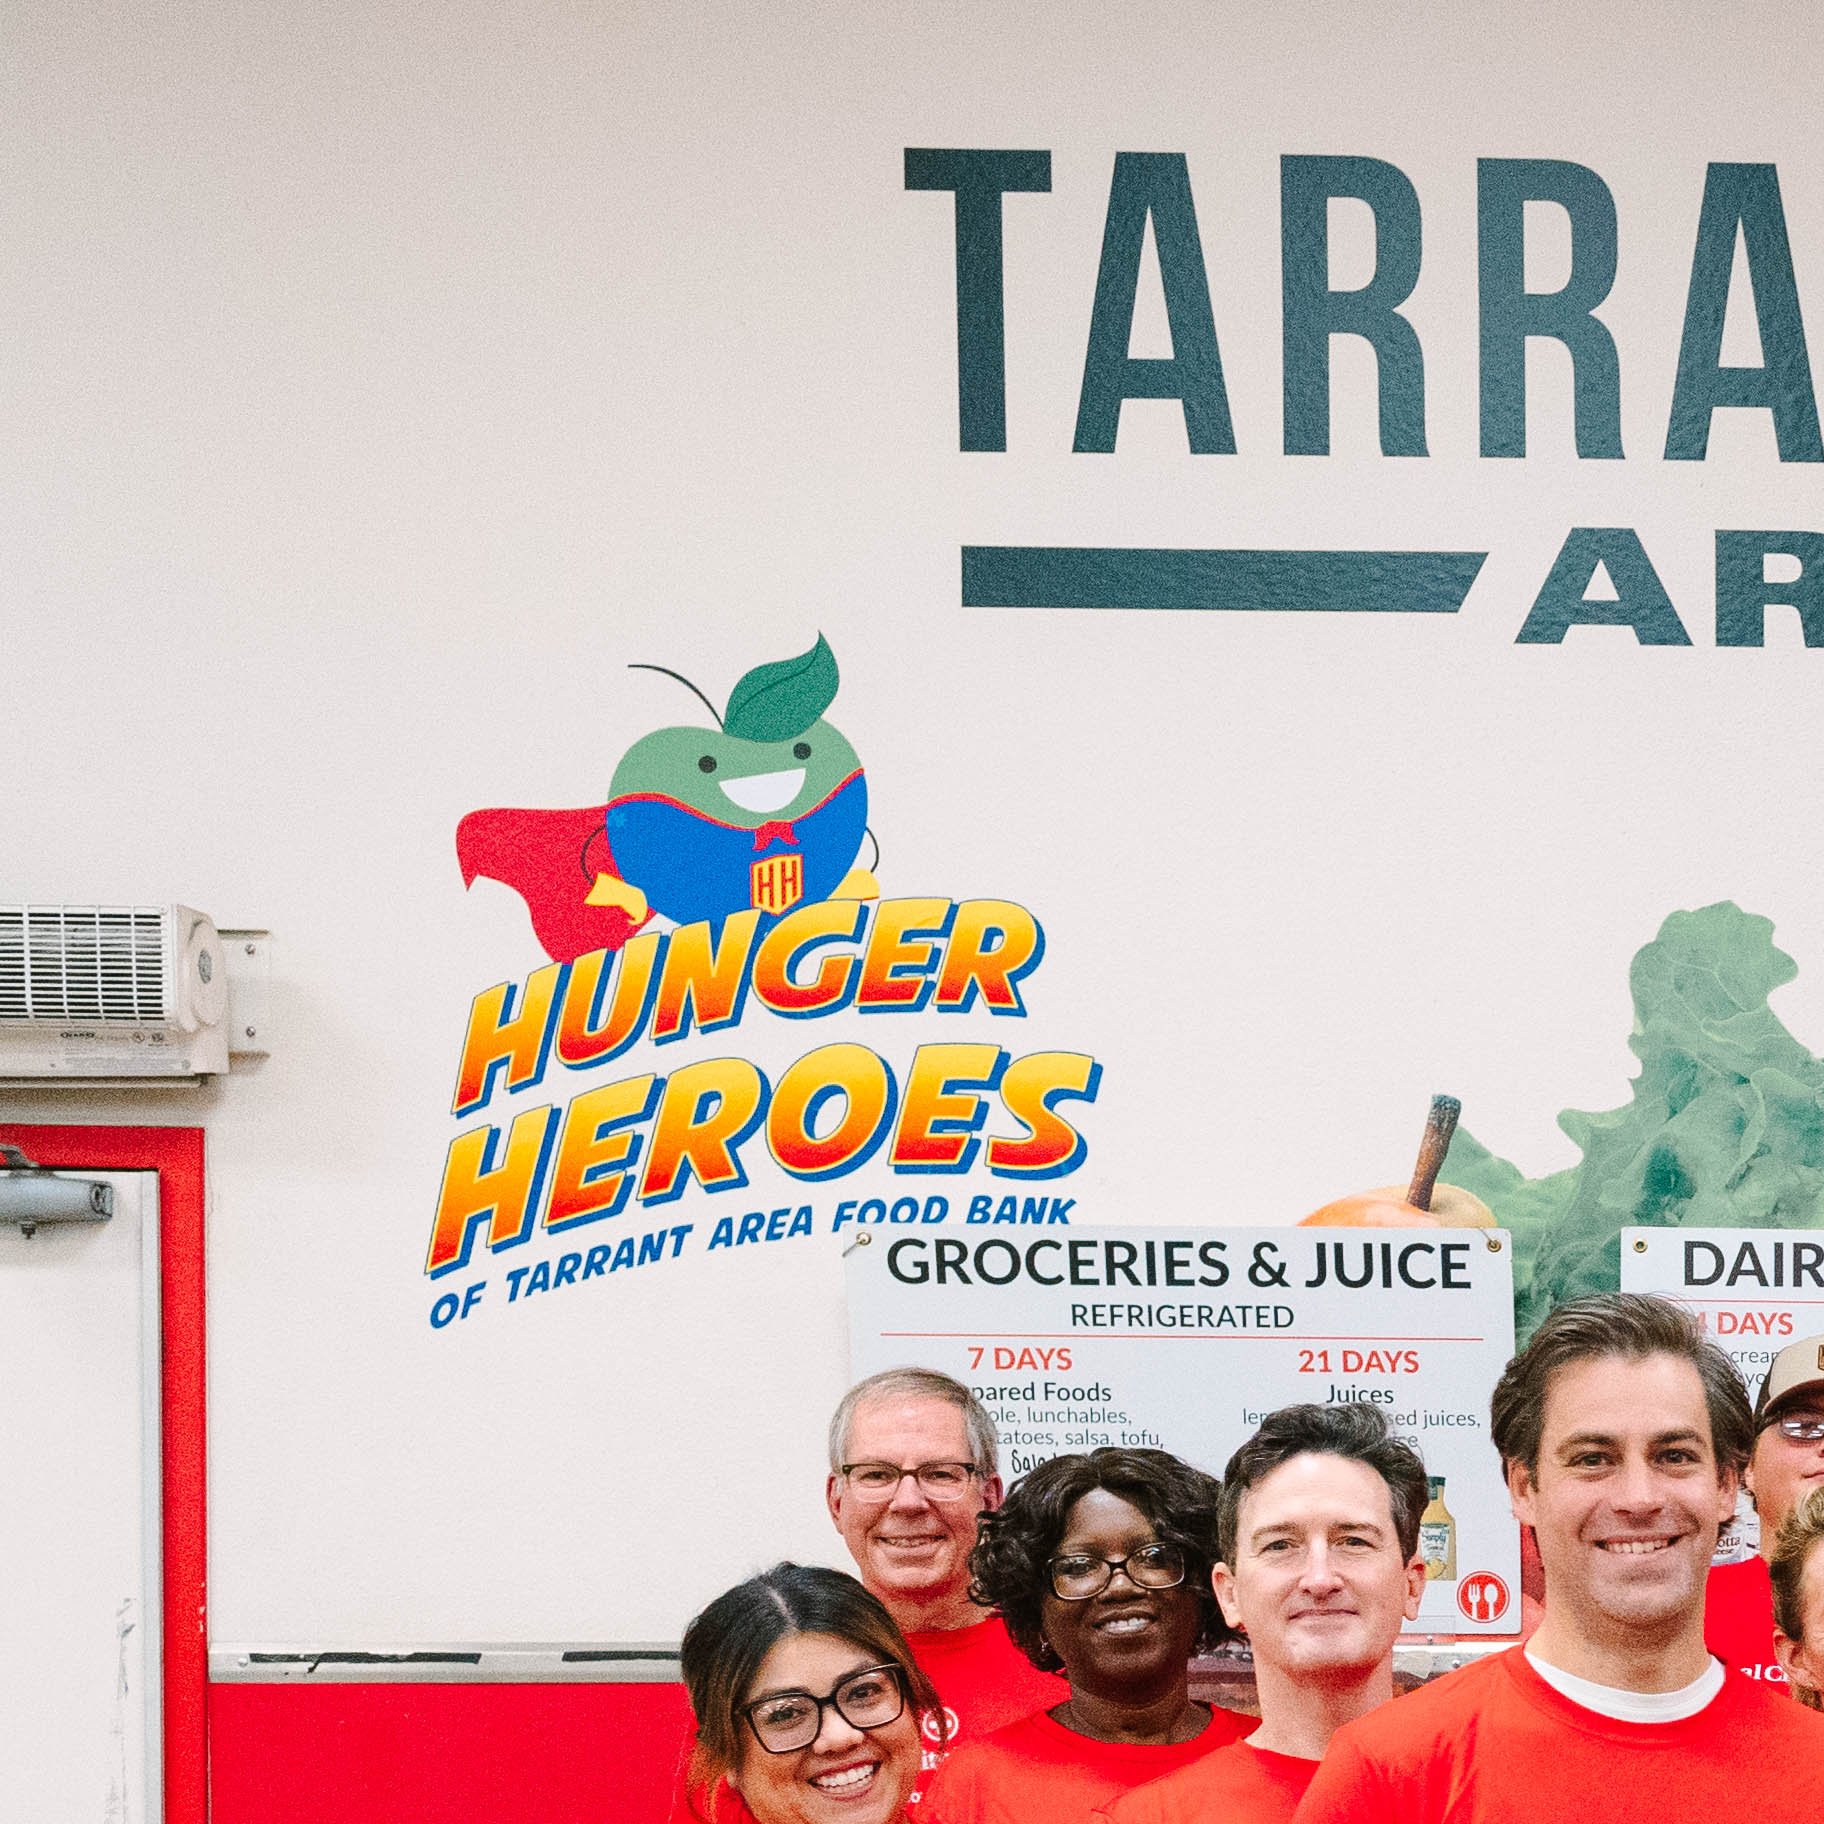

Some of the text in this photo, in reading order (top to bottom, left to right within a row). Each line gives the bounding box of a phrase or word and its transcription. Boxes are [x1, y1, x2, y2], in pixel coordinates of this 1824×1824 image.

[758, 860, 797, 907] HH
[452, 898, 1045, 1116] HUNGER
[425, 1042, 1103, 1280] HEROES
[429, 1194, 1077, 1329] OF TARRANT AREA FOOD BANK
[888, 1237, 1472, 1289] GROCERIES & JUICE
[1070, 1303, 1294, 1329] REFRIGERATED
[1718, 1312, 1795, 1335] DAYS
[968, 1347, 1073, 1371] 7 DAYS
[1298, 1350, 1420, 1374] 21 DAYS
[972, 1382, 1112, 1402] pared Foods
[1326, 1385, 1394, 1404] Juices
[1028, 1407, 1132, 1426] lunchables,
[1423, 1410, 1481, 1430] juices,
[996, 1429, 1164, 1449] tatoes, salsa, tofu,
